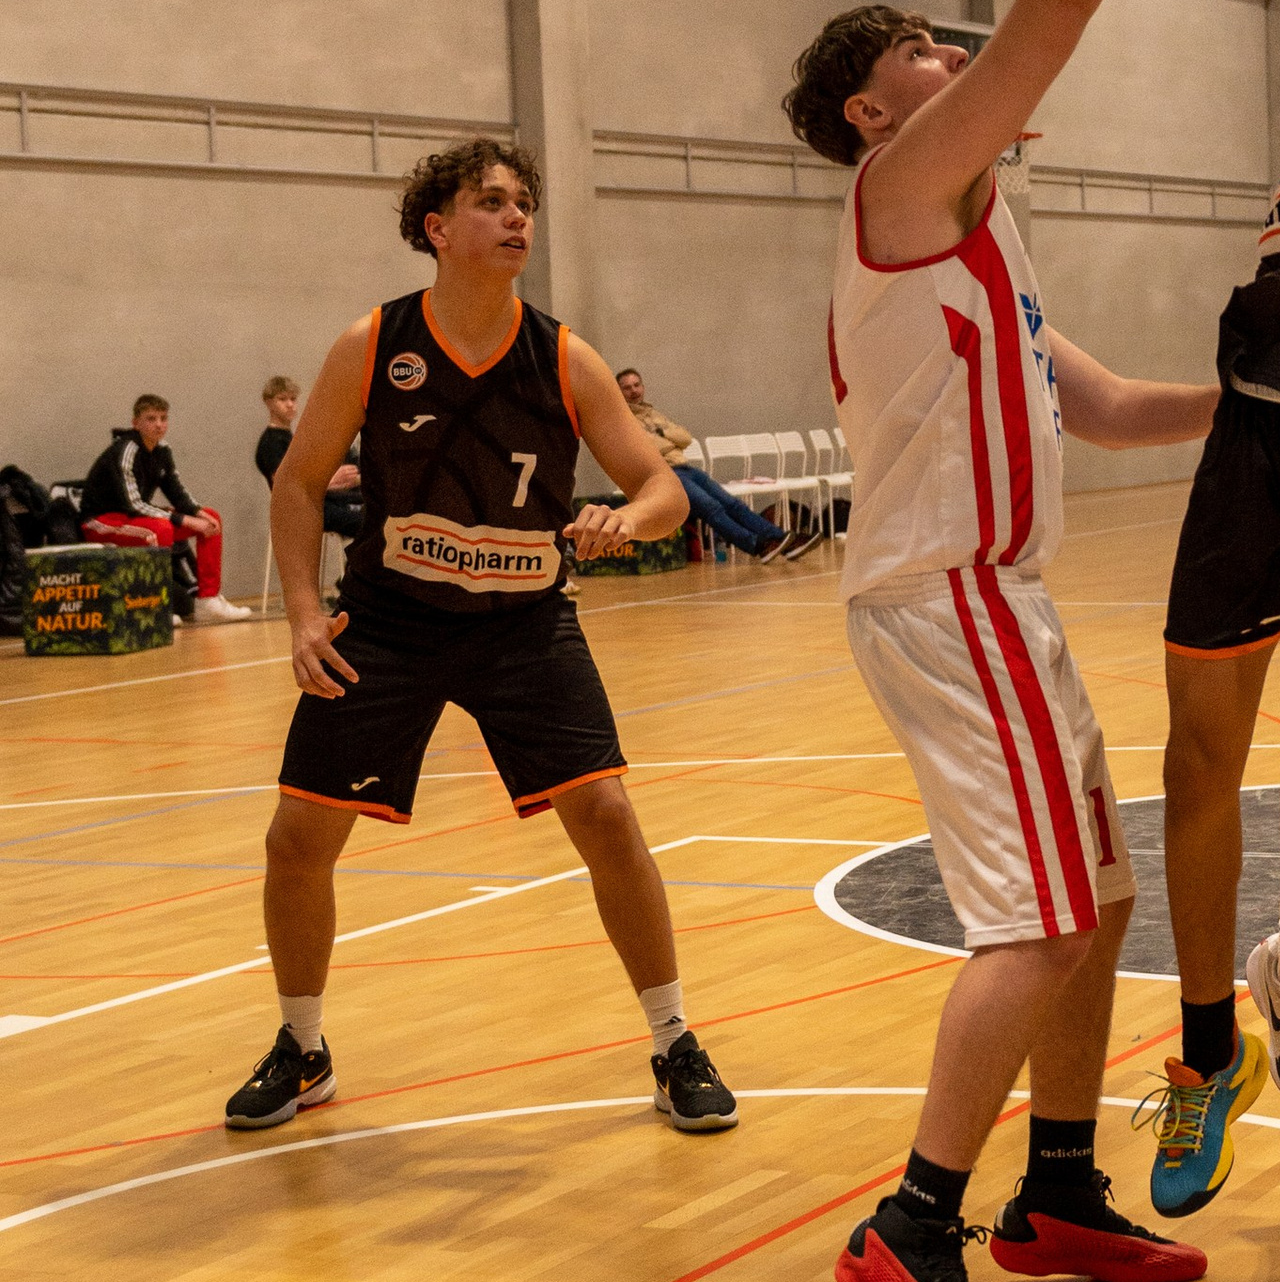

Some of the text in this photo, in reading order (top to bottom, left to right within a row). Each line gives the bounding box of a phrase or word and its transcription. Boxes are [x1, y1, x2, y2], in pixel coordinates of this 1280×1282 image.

[510, 452, 537, 508] 7
[402, 532, 542, 573] ratiopharm
[39, 573, 83, 586] MACHT
[32, 584, 101, 603] APPETIT
[58, 601, 83, 613] AUF
[37, 611, 107, 633] NATUR.
[1040, 1146, 1093, 1159] adidas
